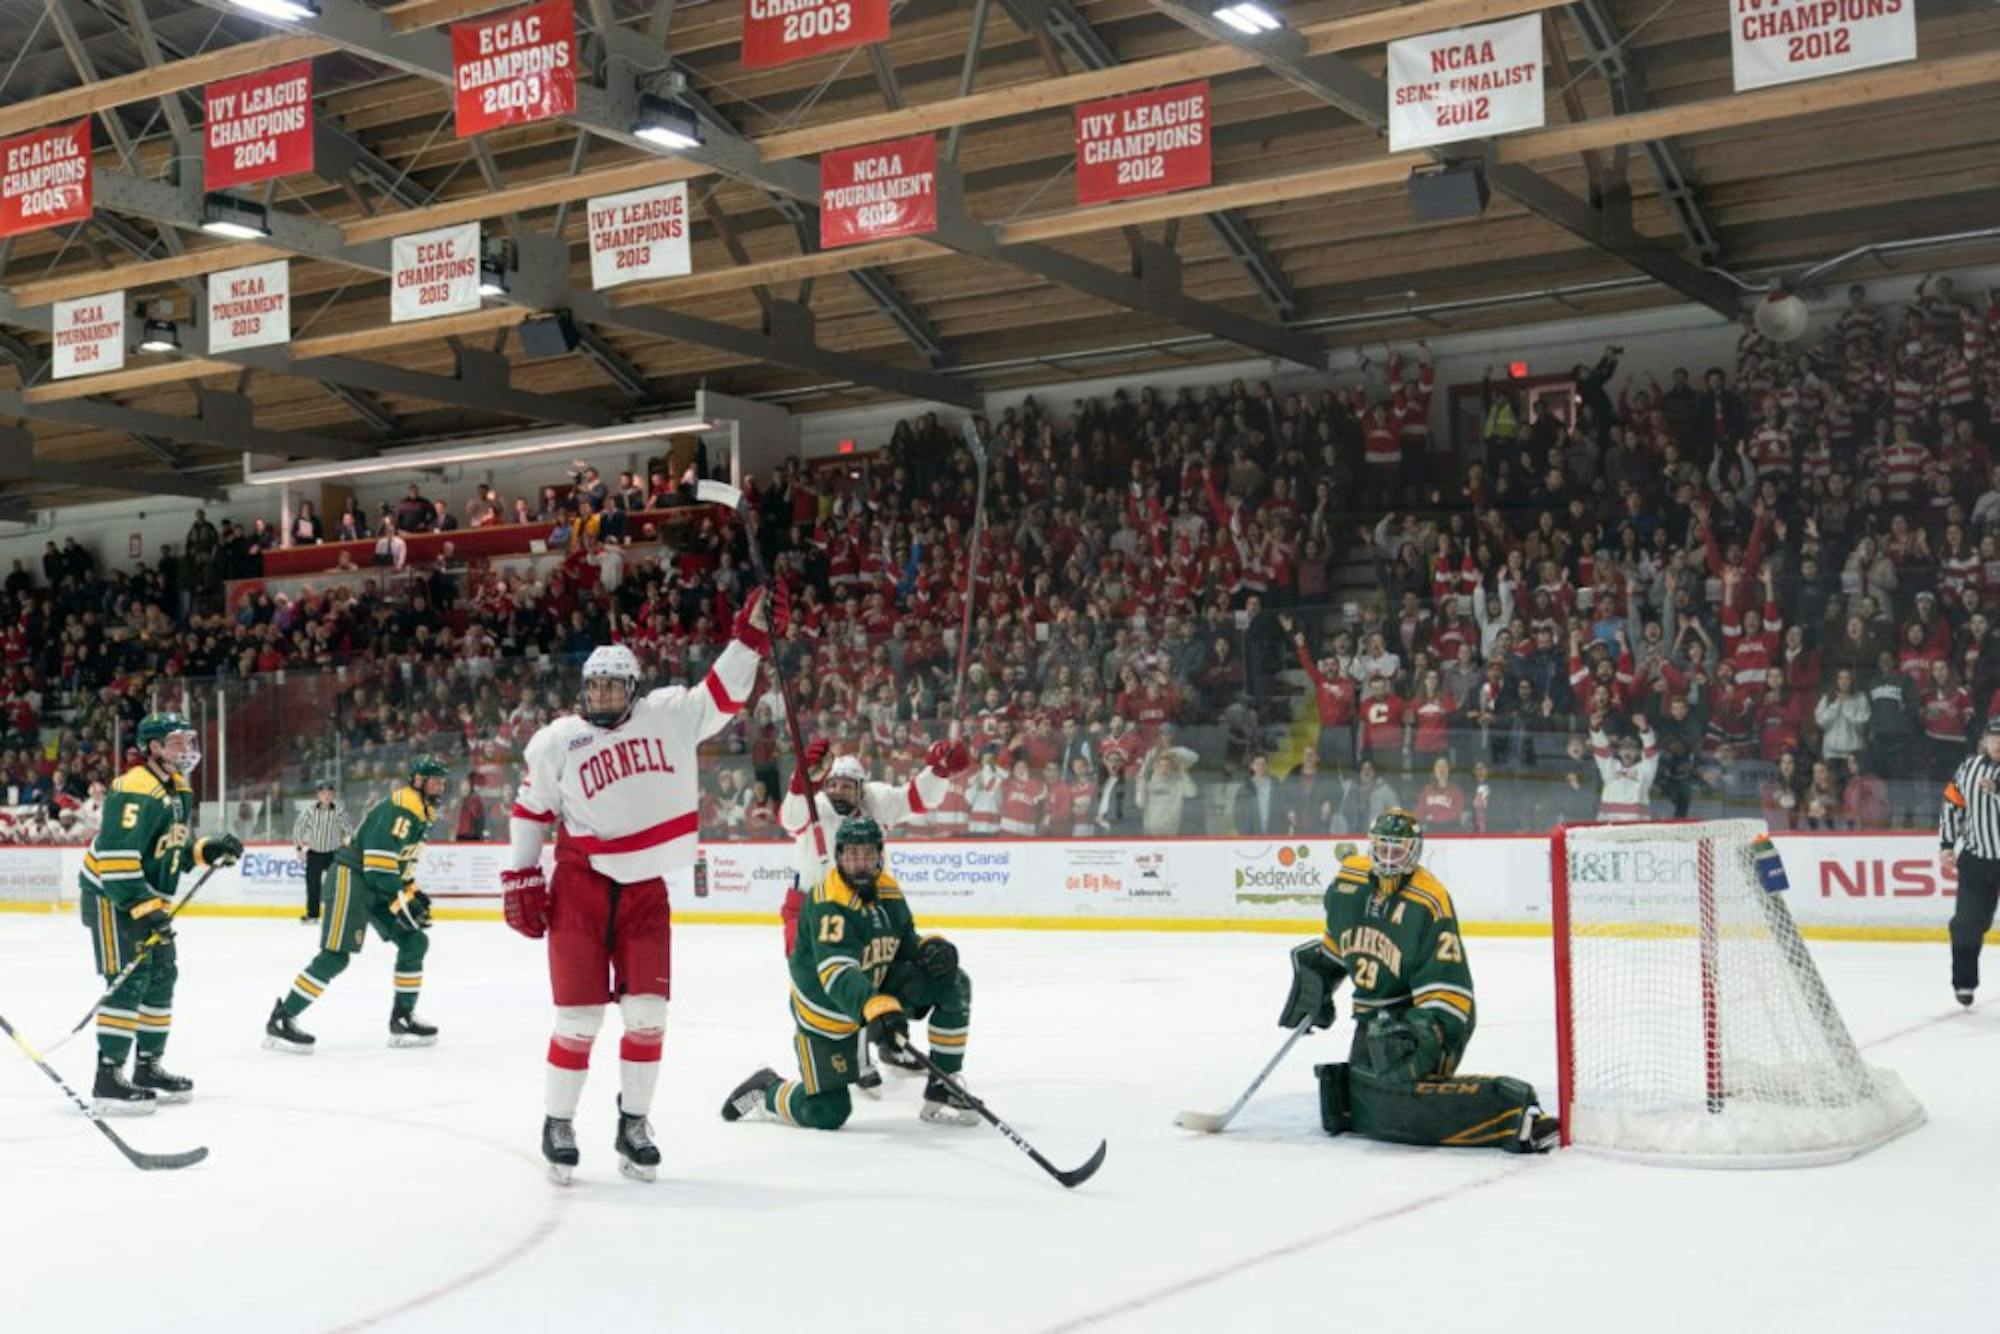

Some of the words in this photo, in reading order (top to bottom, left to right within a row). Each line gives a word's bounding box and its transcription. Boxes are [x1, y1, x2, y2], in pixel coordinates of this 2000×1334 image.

[479, 16, 541, 55] ECAC
[783, 2, 851, 43] 2003
[1742, 0, 1903, 41] CHAMPIONS
[1430, 40, 1495, 73] NCAA
[1788, 28, 1851, 62] 2012
[459, 40, 569, 91] CHAMPIONS
[208, 94, 236, 122] IVY
[241, 78, 308, 115] LEAGUE
[483, 77, 540, 114] 2003
[211, 105, 305, 149] CHAMPIONS
[1081, 113, 1115, 140] IVY
[1123, 96, 1204, 133] LEAGUE
[1437, 97, 1490, 127] 2012
[234, 138, 277, 170] 2004
[1084, 122, 1202, 165] CHAMPIONS
[3, 156, 86, 198] CHAMPIONS
[853, 154, 903, 182] NCAA
[1117, 155, 1164, 184] 2012
[21, 186, 66, 217] 2005
[823, 172, 933, 211] TOURNAMENT
[591, 208, 616, 230] IVY
[622, 195, 683, 225] LEAGUE
[595, 218, 682, 252] CHAMPIONS
[417, 240, 454, 264] ECAC
[616, 246, 651, 269] 2013
[231, 276, 265, 298] NCAA
[397, 257, 476, 288] CHAMPIONS
[213, 293, 284, 321] TOURNAMENT
[419, 283, 450, 305] 2013
[231, 317, 260, 337] 2013
[1368, 704, 1389, 723] C
[579, 738, 674, 800] CORNELL
[121, 804, 140, 829] 5
[752, 866, 796, 881] cherib
[891, 851, 963, 869] Chemung
[966, 851, 1010, 865] Canal
[1634, 852, 1697, 882] Ban
[892, 869, 929, 882] Trust
[933, 868, 1010, 886] Company
[1245, 863, 1321, 890] Sedgwick
[818, 915, 845, 942] 13
[1390, 901, 1407, 925] A
[1340, 926, 1402, 979] CLARKSON
[1354, 957, 1379, 990] 29
